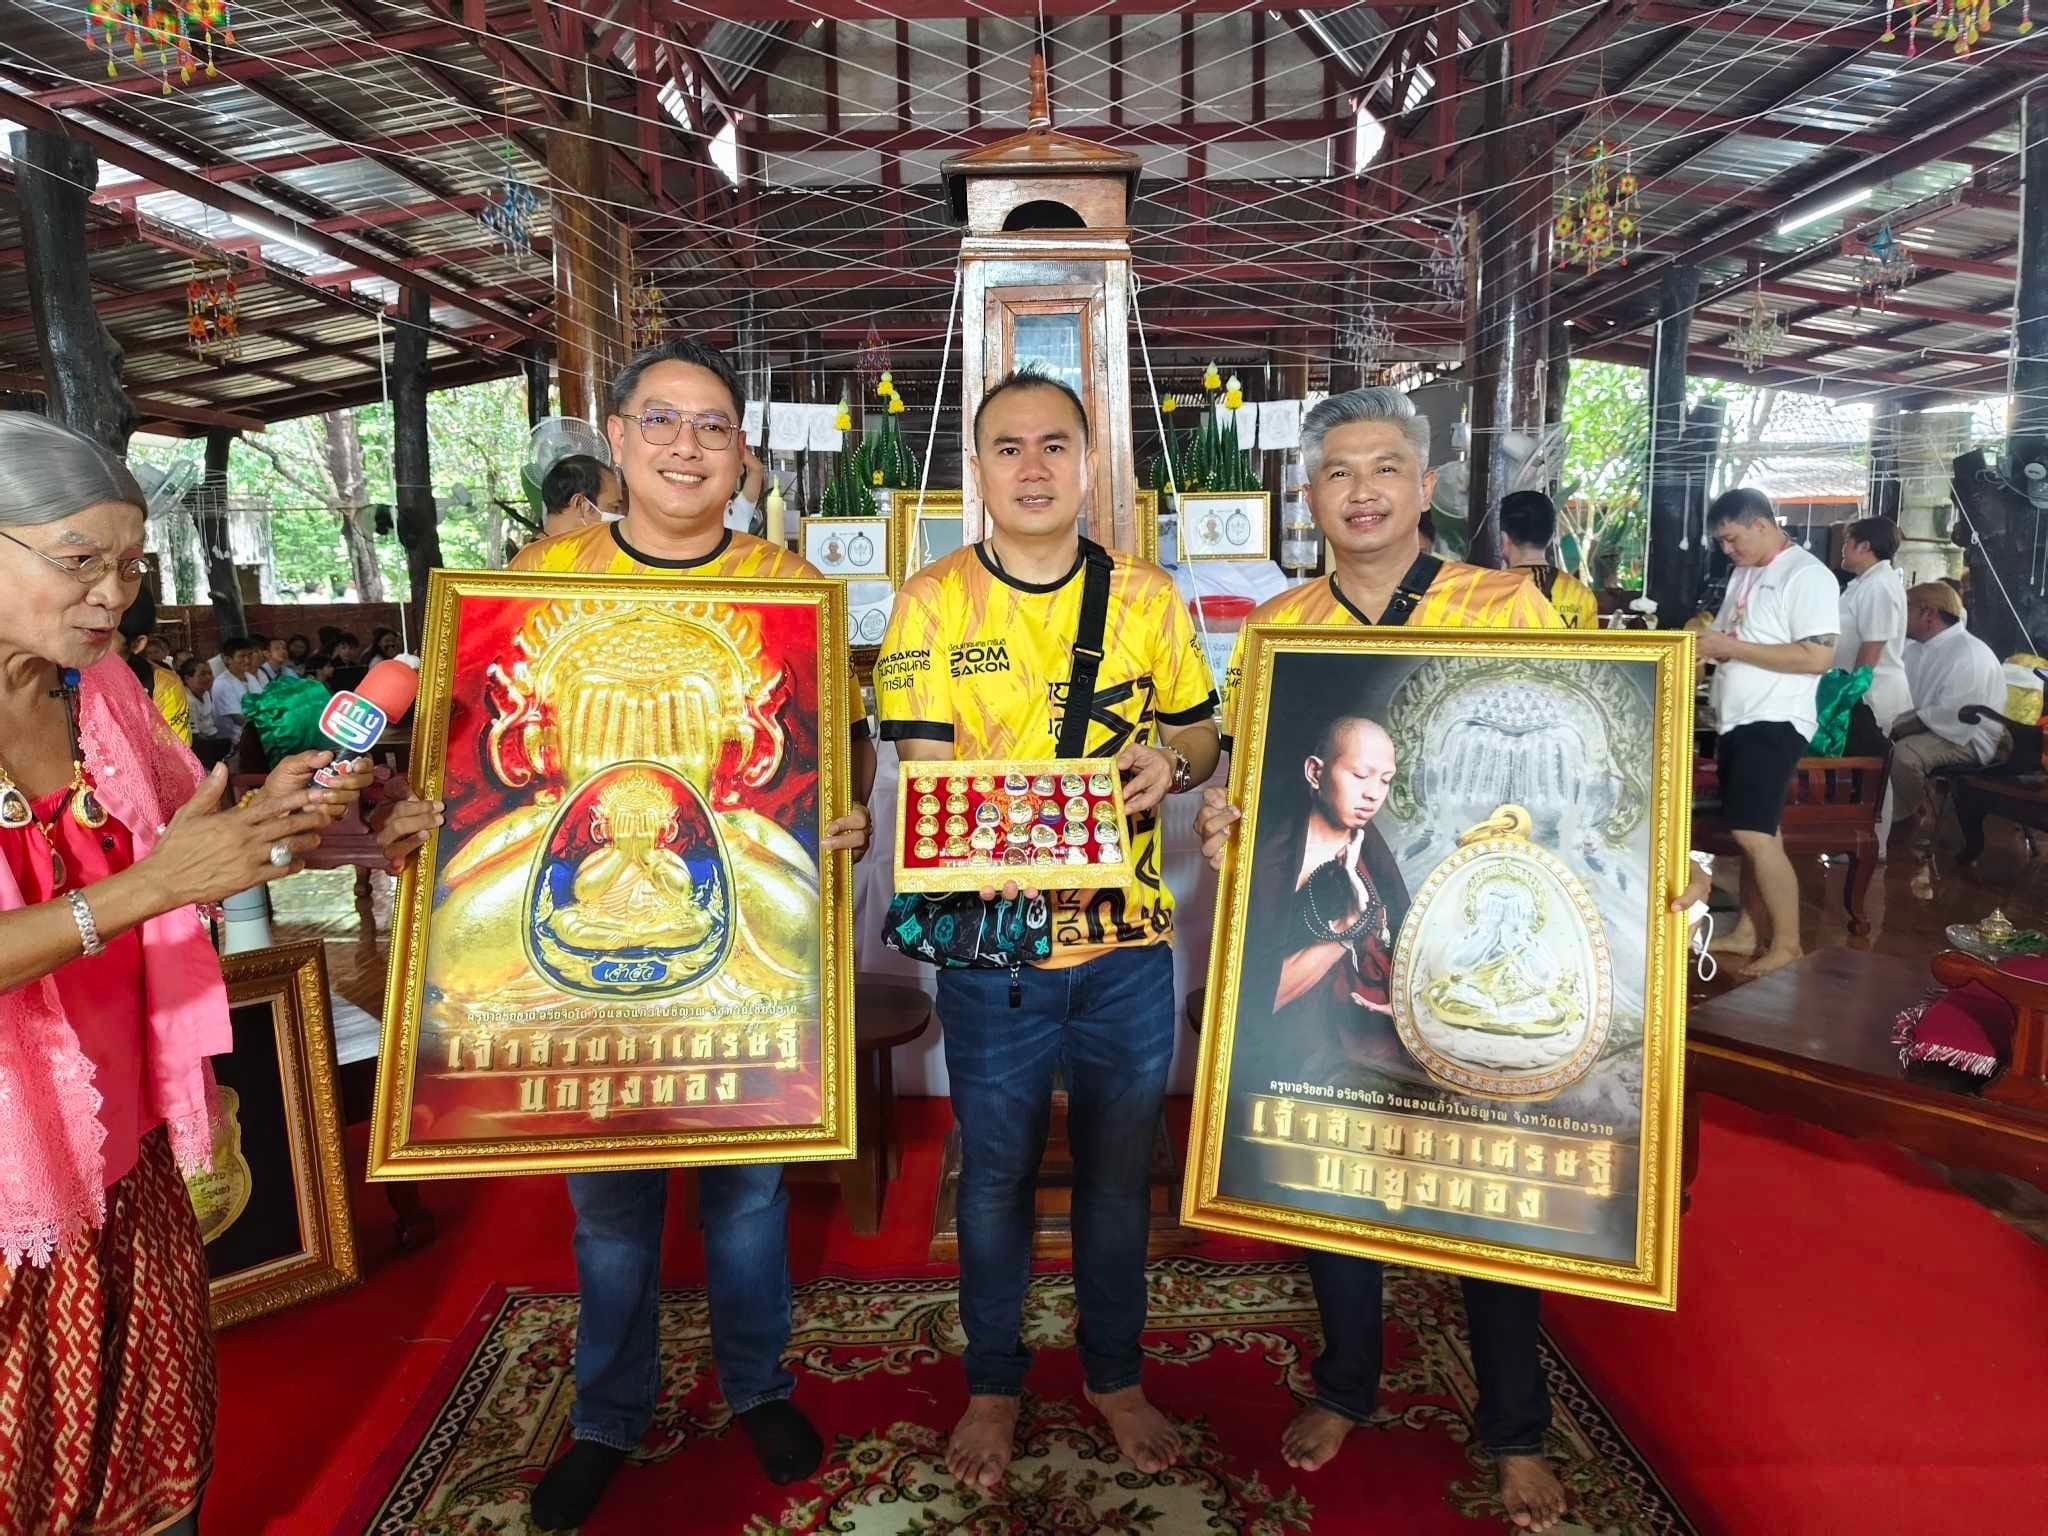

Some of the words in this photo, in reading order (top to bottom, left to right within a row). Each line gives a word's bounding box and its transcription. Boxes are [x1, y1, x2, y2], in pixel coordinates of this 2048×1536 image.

[950, 646, 1009, 667] POM
[950, 661, 1011, 678] SAKON
[448, 1022, 801, 1071] เจ้าสัวมหาเศรษฐี
[520, 1072, 740, 1120] นกยูงทอง
[1252, 1098, 1615, 1197] เจ้าสัวมหาเศรษฐี
[1315, 1153, 1543, 1219] นกยูงทอง
